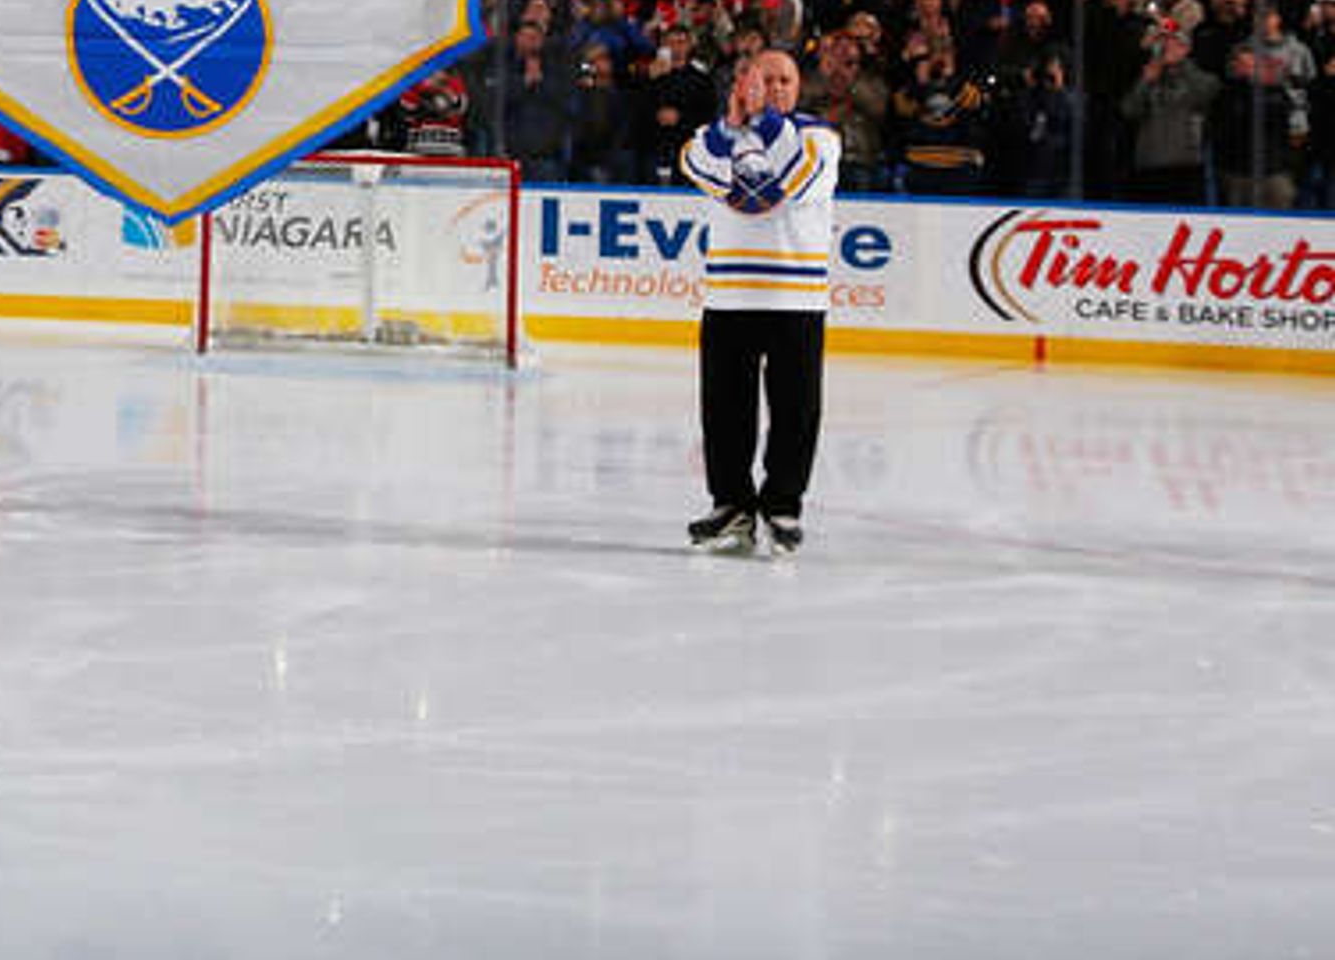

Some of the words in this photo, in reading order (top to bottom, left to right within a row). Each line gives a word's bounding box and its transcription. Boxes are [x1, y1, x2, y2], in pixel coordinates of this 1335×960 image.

[1015, 218, 1138, 294] Tim
[539, 262, 705, 306] Technolog
[1074, 297, 1148, 322] CAFE
[1177, 303, 1255, 329] BAKE
